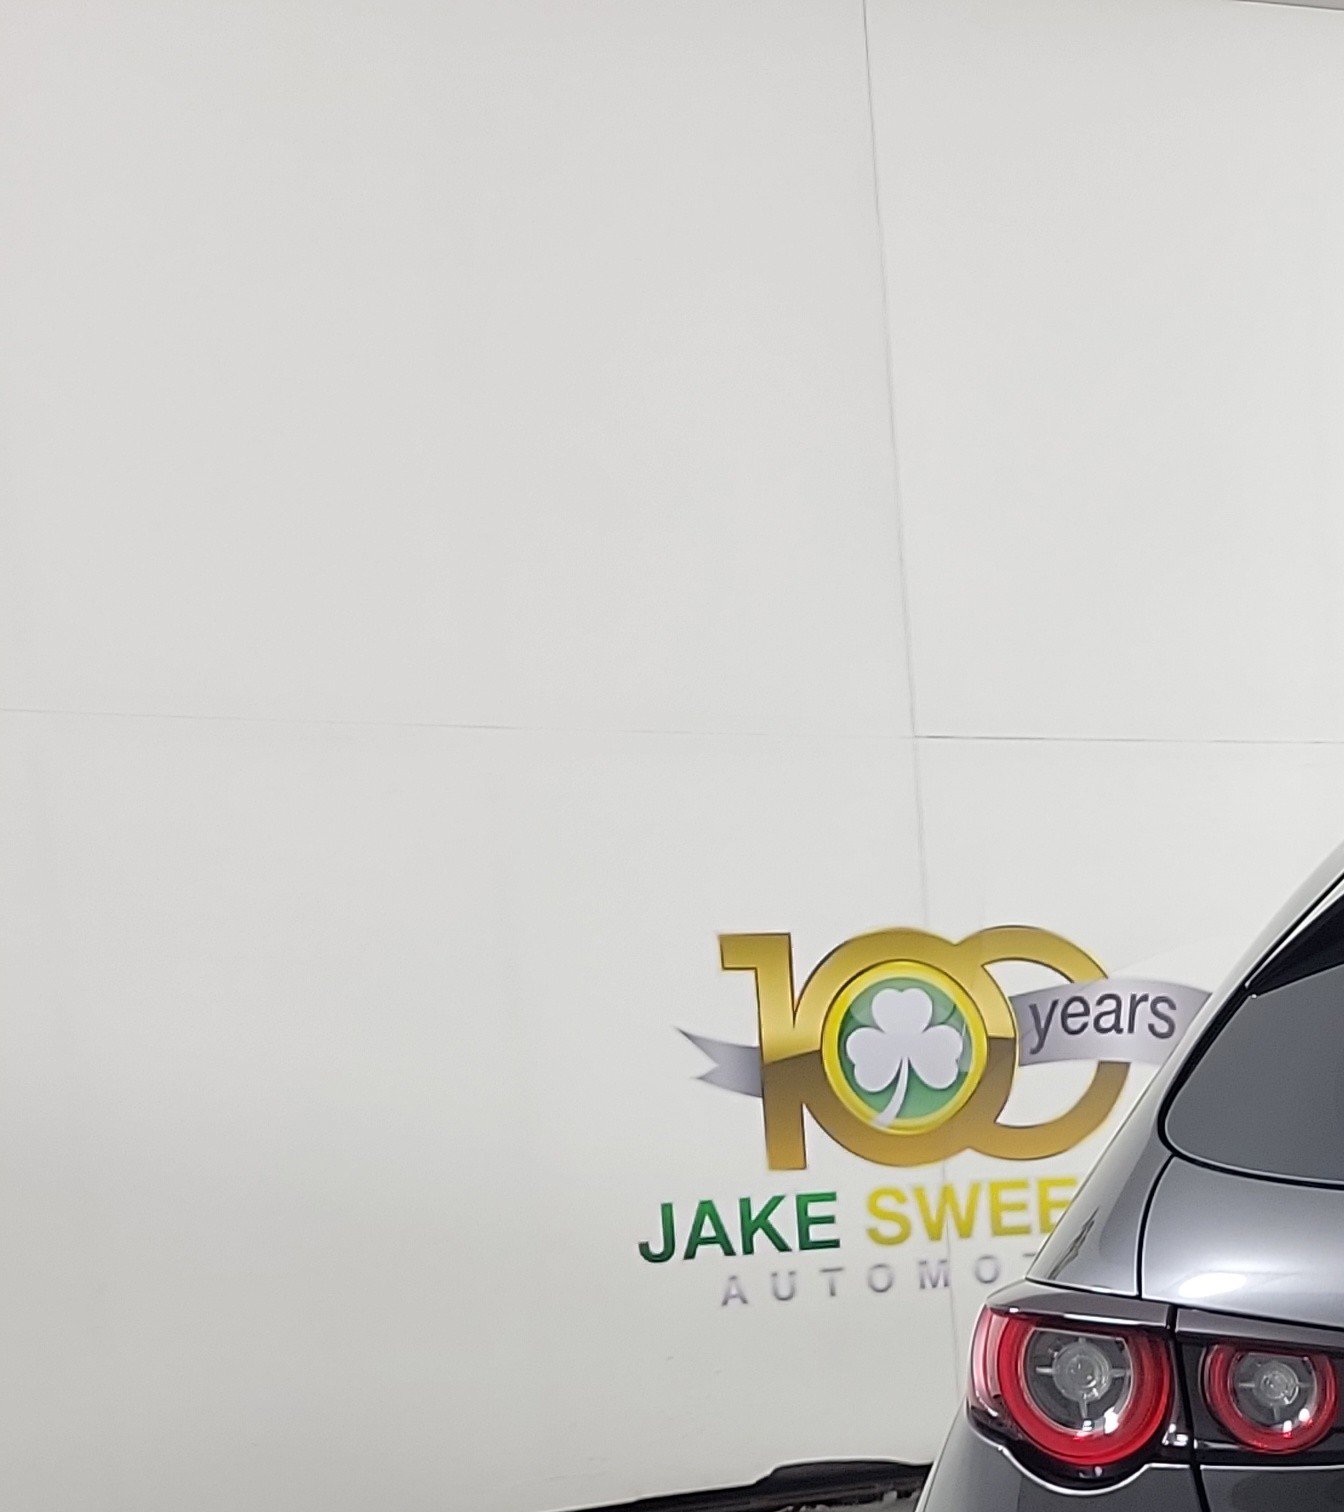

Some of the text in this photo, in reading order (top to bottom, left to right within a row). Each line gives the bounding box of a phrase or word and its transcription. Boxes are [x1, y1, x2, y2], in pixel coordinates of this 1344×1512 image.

[718, 925, 1177, 1170] 100 years
[638, 1190, 841, 1264] JAKE
[720, 1252, 1037, 1306] AUTOMO
